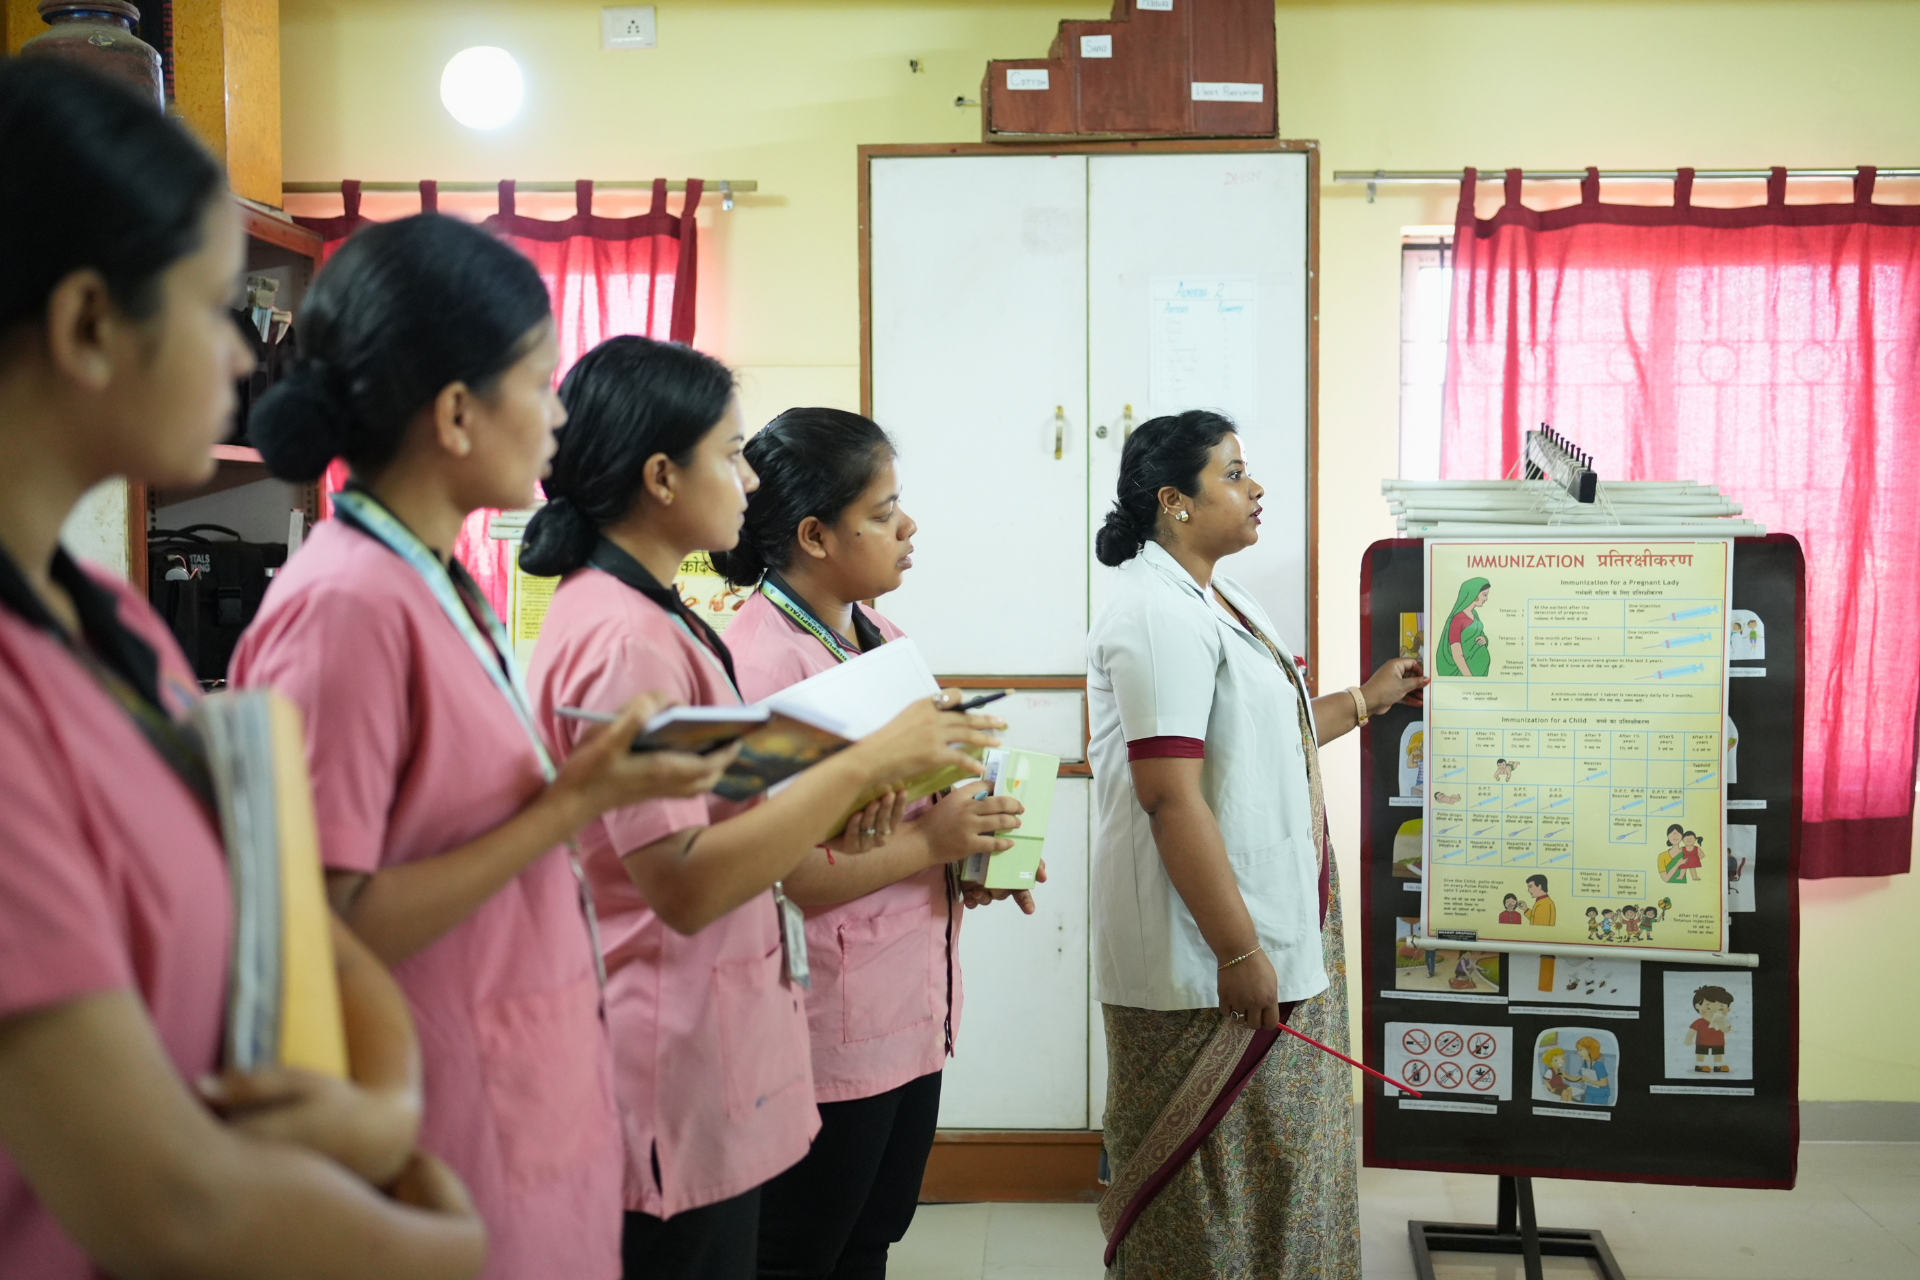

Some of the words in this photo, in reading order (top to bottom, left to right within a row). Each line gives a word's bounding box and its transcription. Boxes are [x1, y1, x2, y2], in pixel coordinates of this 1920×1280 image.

[1467, 555, 1584, 568] IMMUNIZATION
[1596, 549, 1694, 568] प्रतिरक्षीकरण
[1629, 579, 1661, 587] Pregnant
[1662, 579, 1680, 587] Lady
